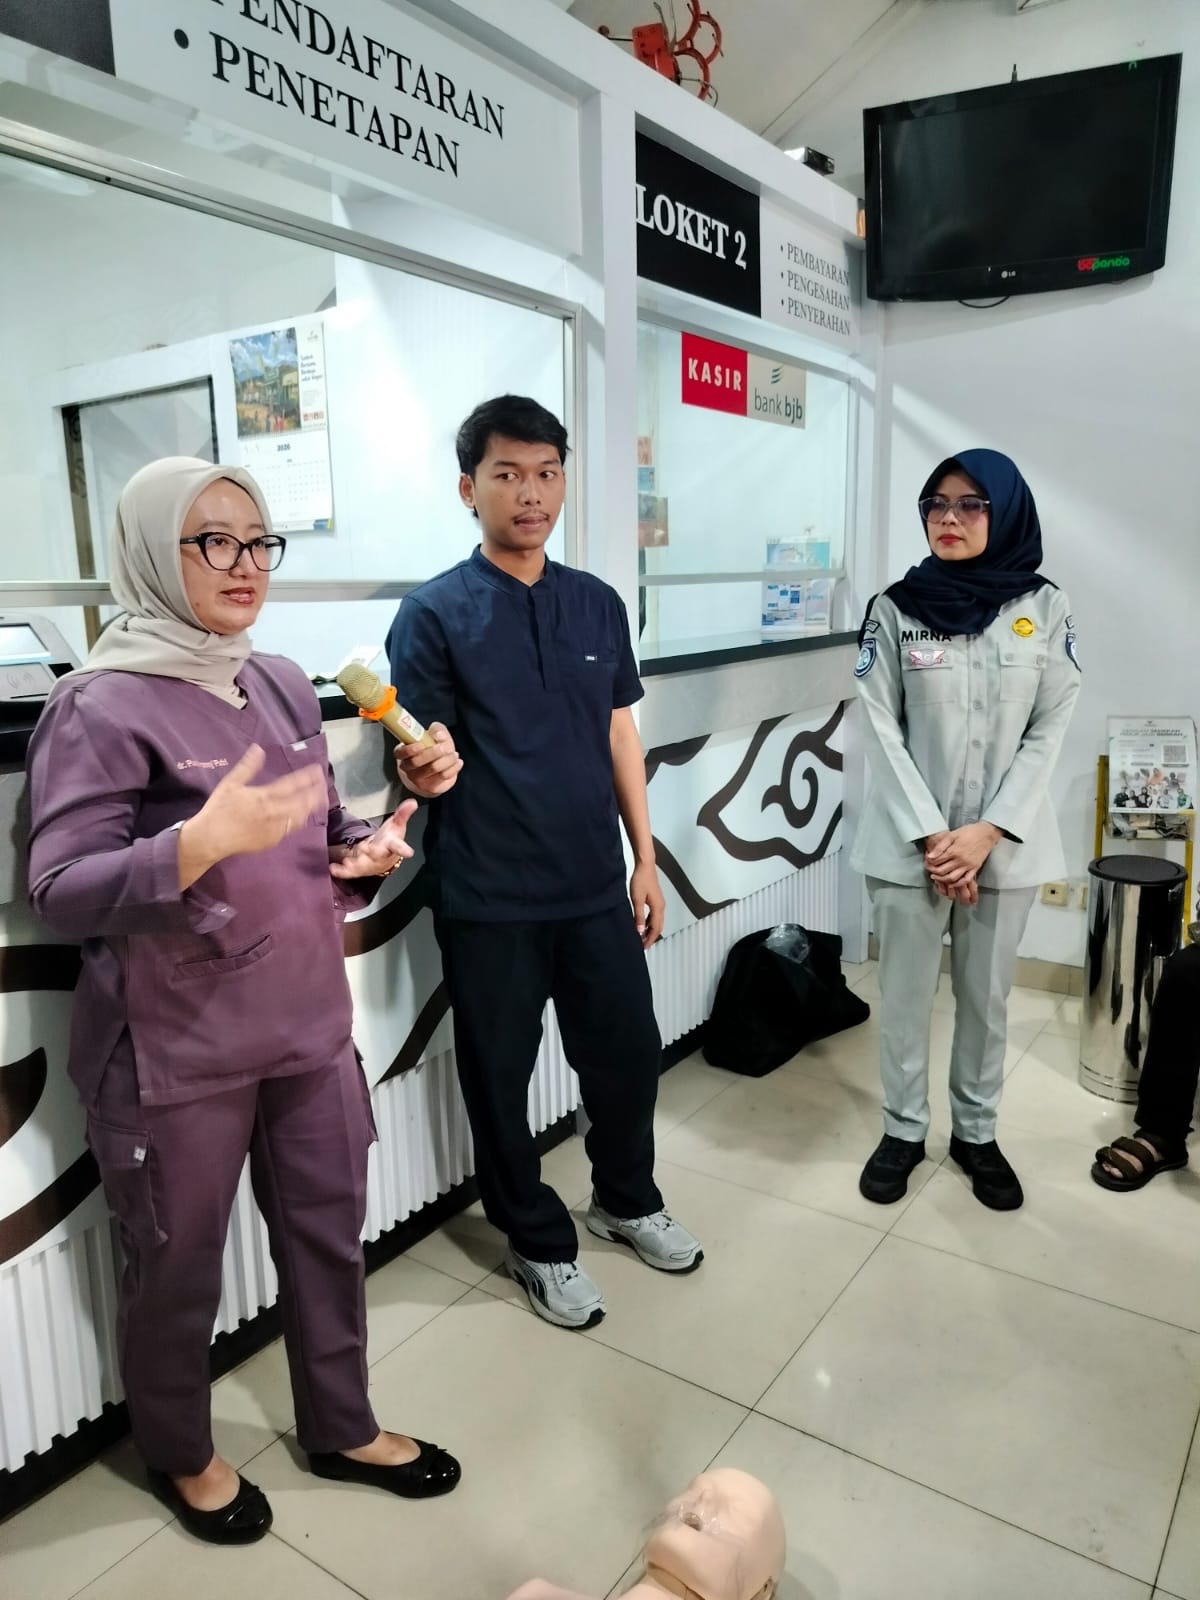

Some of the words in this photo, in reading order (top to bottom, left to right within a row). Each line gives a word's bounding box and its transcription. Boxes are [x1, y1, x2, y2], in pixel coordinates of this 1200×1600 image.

[211, 0, 505, 141] ENDAFTARAN
[208, 31, 459, 178] PENETAPAN
[636, 183, 729, 260] LOKET
[734, 229, 747, 271] 2
[787, 242, 849, 287] PEMBAYARAN
[787, 270, 850, 312] PENGESAHAN
[787, 297, 851, 336] PENYERAHAN
[688, 357, 742, 392] KASIR
[754, 388, 782, 415] bank
[785, 396, 803, 423] bjb
[901, 630, 952, 643] MIRNA
